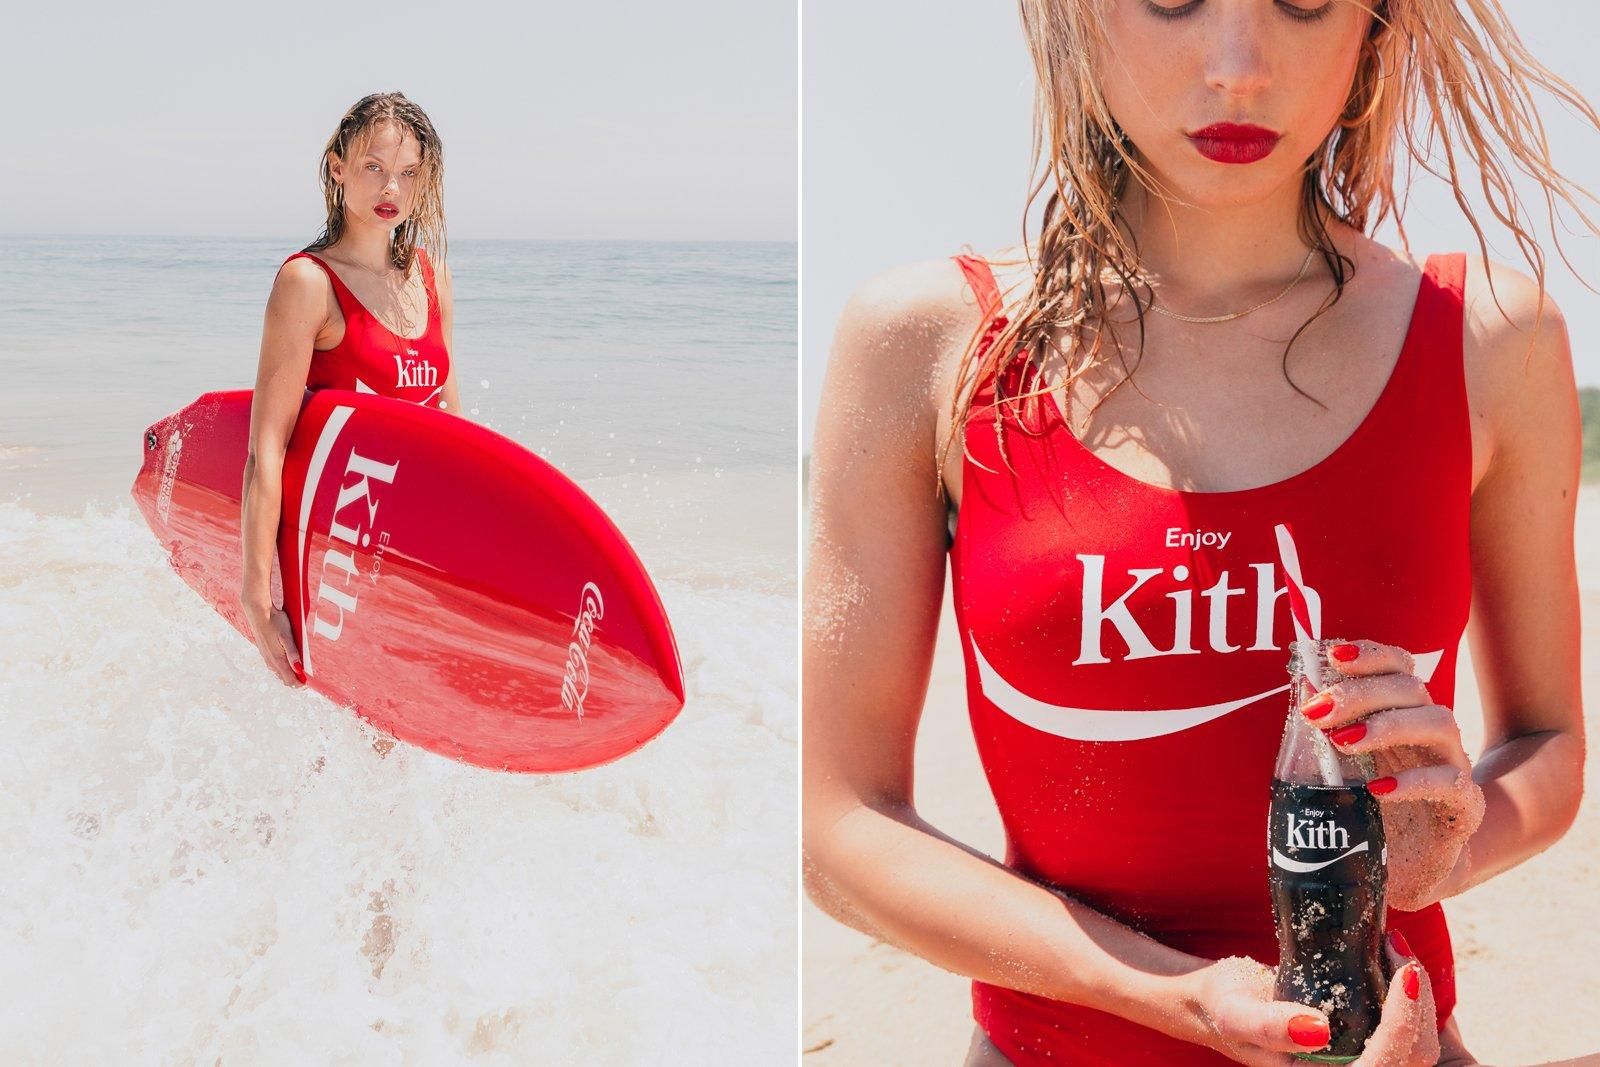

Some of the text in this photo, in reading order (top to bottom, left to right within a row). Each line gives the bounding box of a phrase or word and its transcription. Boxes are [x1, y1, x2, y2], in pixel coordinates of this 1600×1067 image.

[1165, 527, 1232, 550] Enjoy
[368, 531, 391, 586] Enjoy
[1304, 808, 1325, 818] Enjoy
